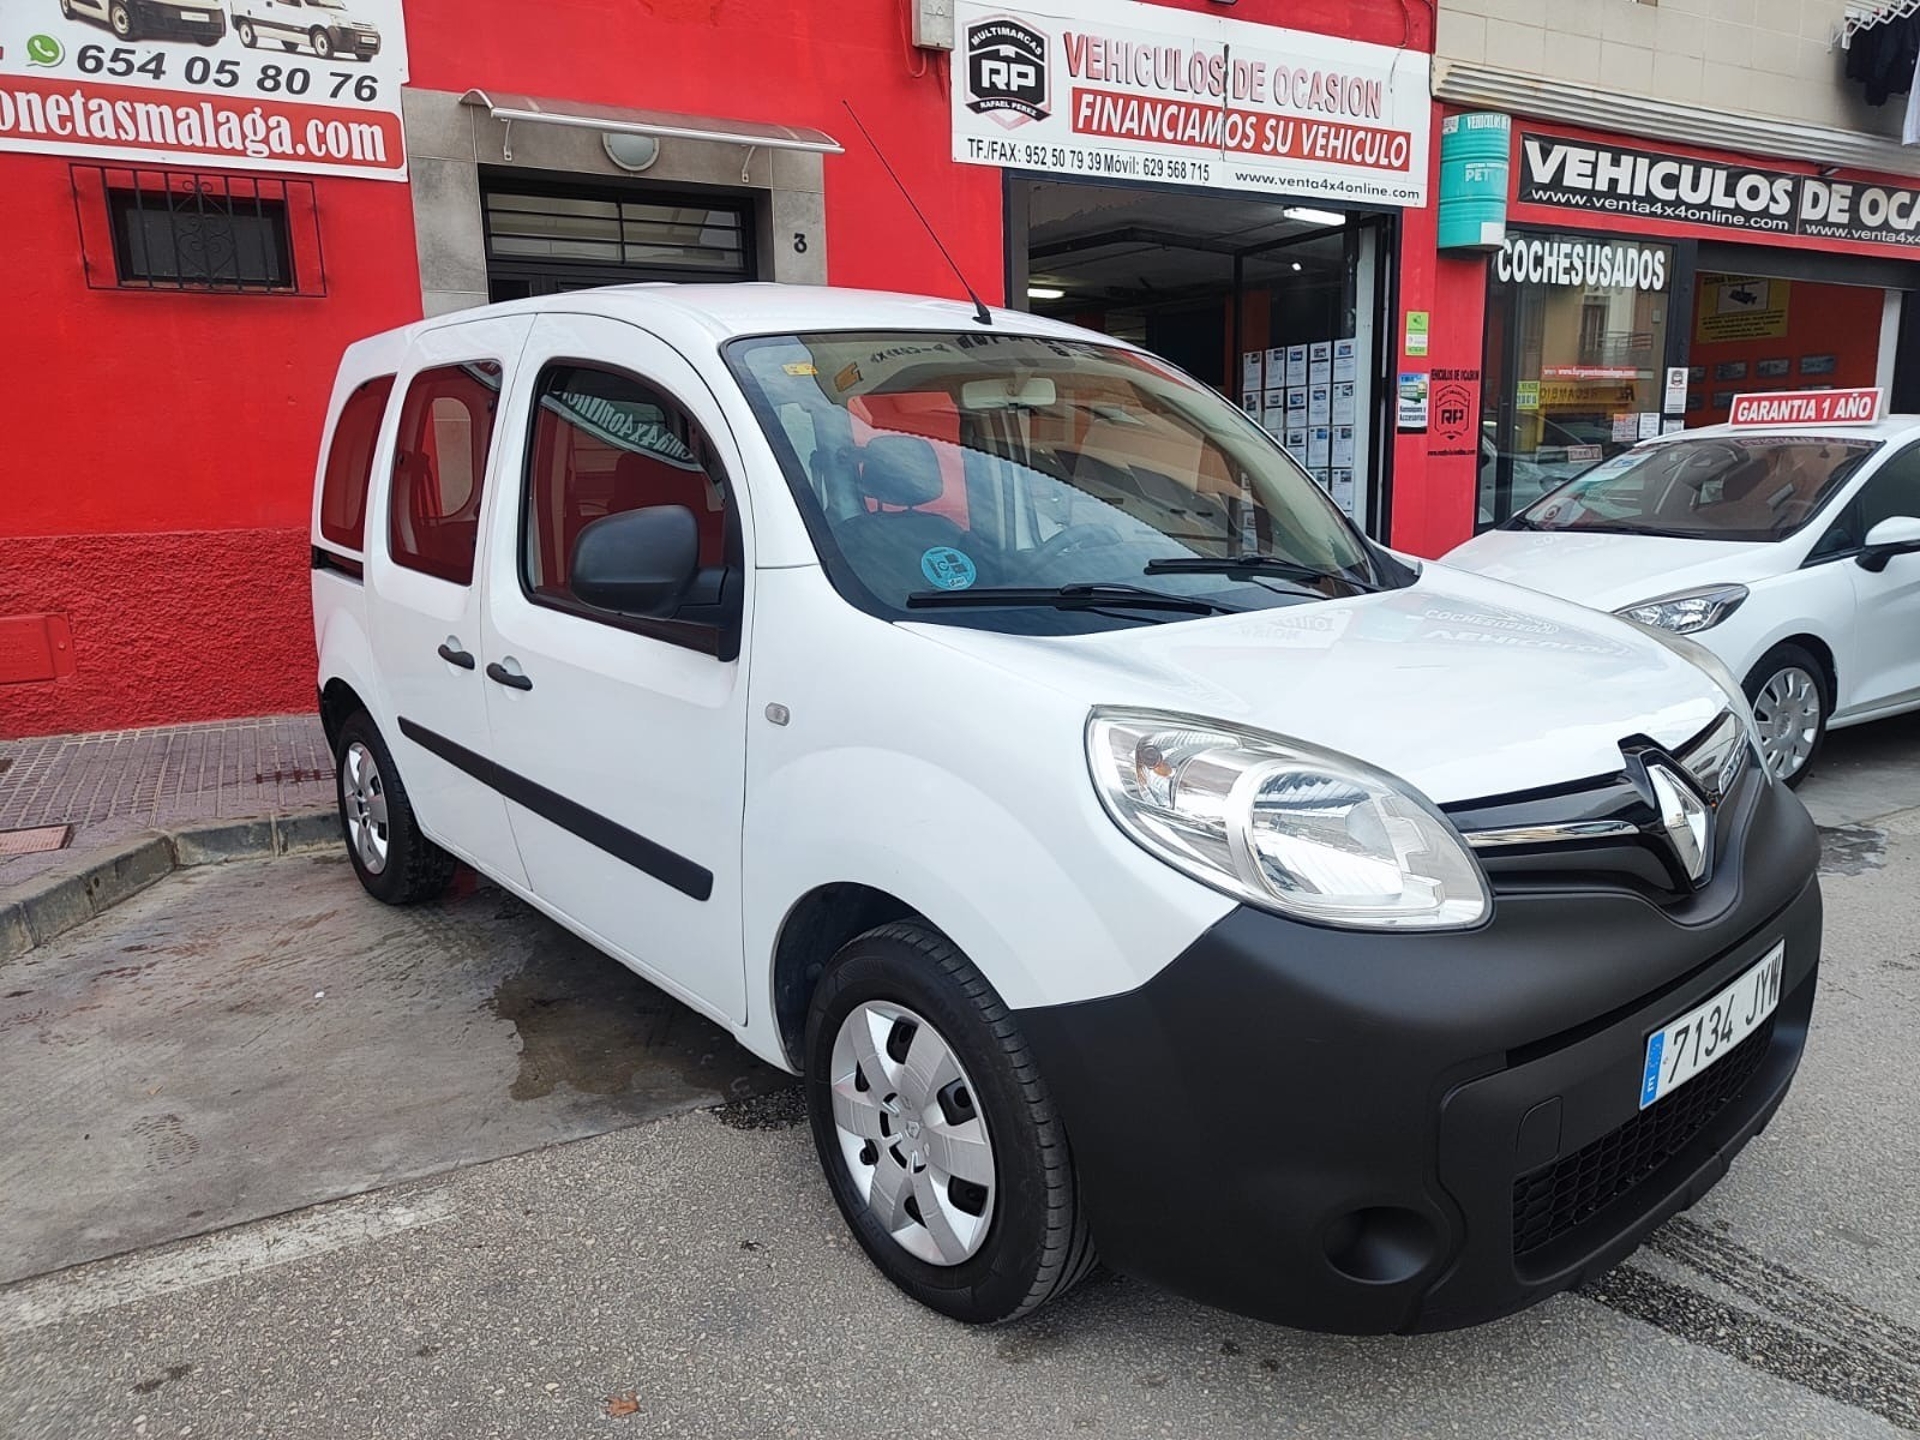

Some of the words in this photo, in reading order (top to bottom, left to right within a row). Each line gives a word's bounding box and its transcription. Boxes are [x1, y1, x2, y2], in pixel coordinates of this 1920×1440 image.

[970, 27, 1043, 55] MULTIMARCAS
[77, 44, 166, 80] 654
[184, 56, 240, 88] 05
[256, 64, 311, 95] 80
[329, 71, 379, 102] 76
[981, 59, 1036, 91] RP
[1063, 31, 1225, 97] VEHICULOS
[1232, 59, 1266, 103] DE
[1273, 65, 1382, 119] OCASION
[1078, 93, 1256, 149] FINANCIAMOS
[1262, 117, 1294, 154] SU
[1301, 122, 1408, 168] VEHICULO
[967, 138, 1021, 164] TF./FAX:
[1025, 144, 1048, 166] 952
[1051, 148, 1066, 168] 50
[1070, 150, 1084, 170] 79
[1087, 153, 1102, 172] 39
[1104, 154, 1140, 175] Móvil:
[1143, 157, 1164, 177] 629
[1167, 162, 1188, 180] 568
[1190, 163, 1210, 182] 715
[1235, 172, 1420, 200] www.venta4x4online.com
[1524, 140, 1793, 216] VEHICULOS
[1800, 180, 1853, 224] DE
[1532, 188, 1789, 231] www.venta4x4online.com
[794, 232, 807, 254] 3
[1737, 399, 1816, 421] GARANTIA
[1822, 398, 1830, 419] 1
[1834, 394, 1871, 419] AÑO
[1668, 994, 1735, 1083] 7134
[1745, 953, 1782, 1026] JYW
